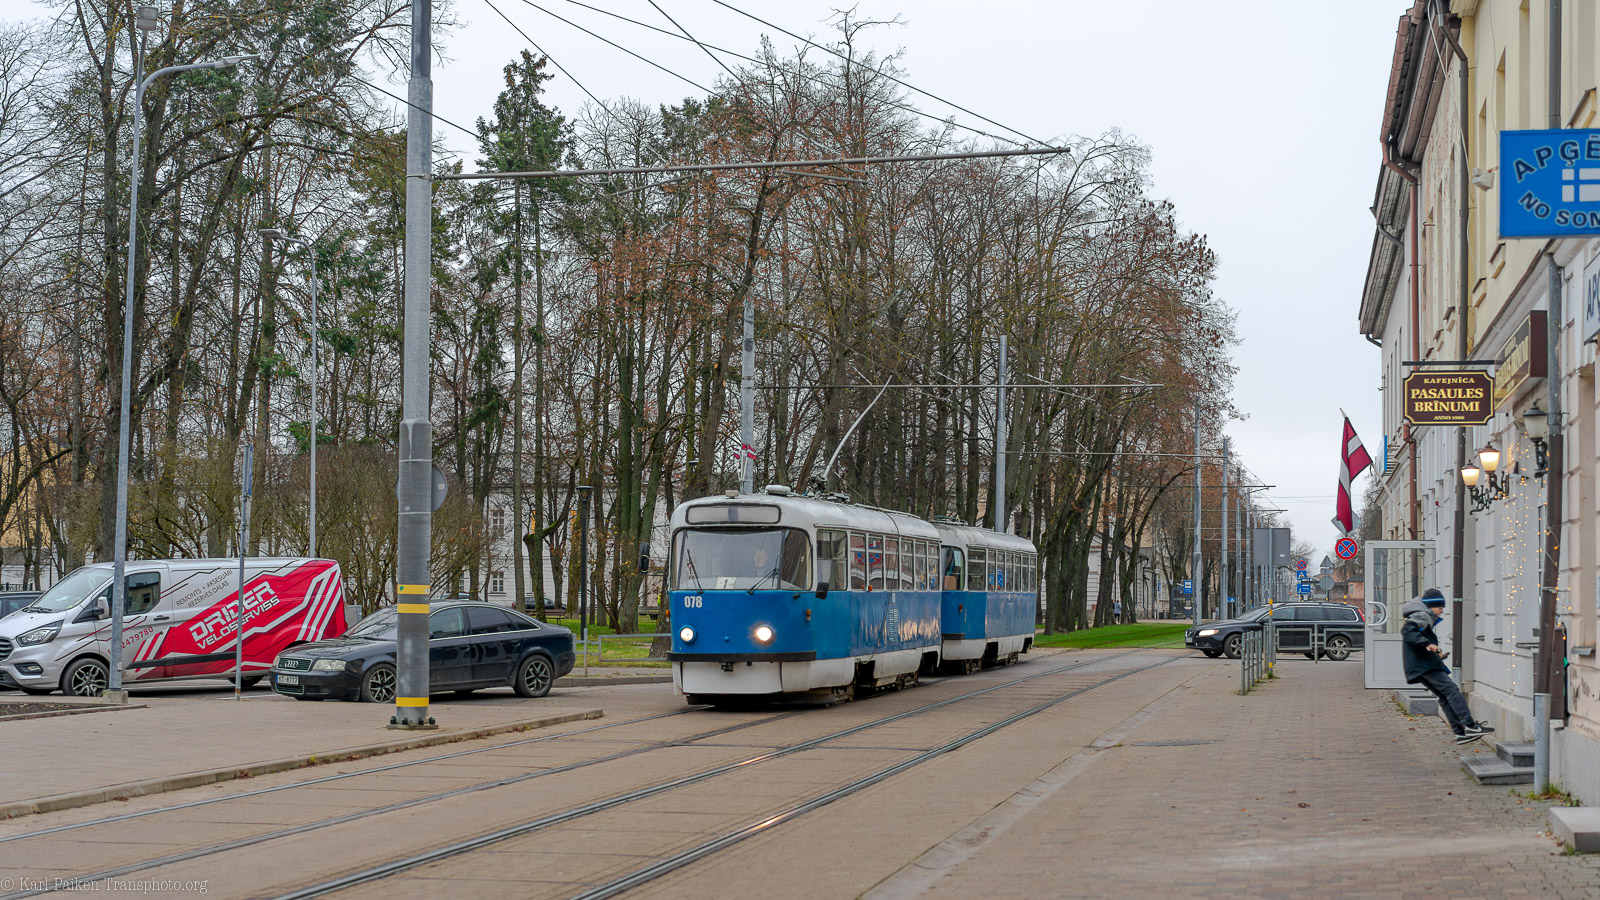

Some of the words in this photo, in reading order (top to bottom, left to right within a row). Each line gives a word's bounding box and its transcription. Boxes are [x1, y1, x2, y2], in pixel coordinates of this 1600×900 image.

[1518, 190, 1551, 219] NO
[1423, 376, 1475, 384] KAFEJNĪCA
[1411, 388, 1484, 399] PASAULES
[1414, 400, 1480, 412] BRĪNUMI
[723, 579, 729, 589] 1
[175, 587, 202, 607] REMONTS
[187, 589, 213, 608] REZERVES
[684, 596, 702, 608] 078
[188, 581, 276, 642] DRIDER
